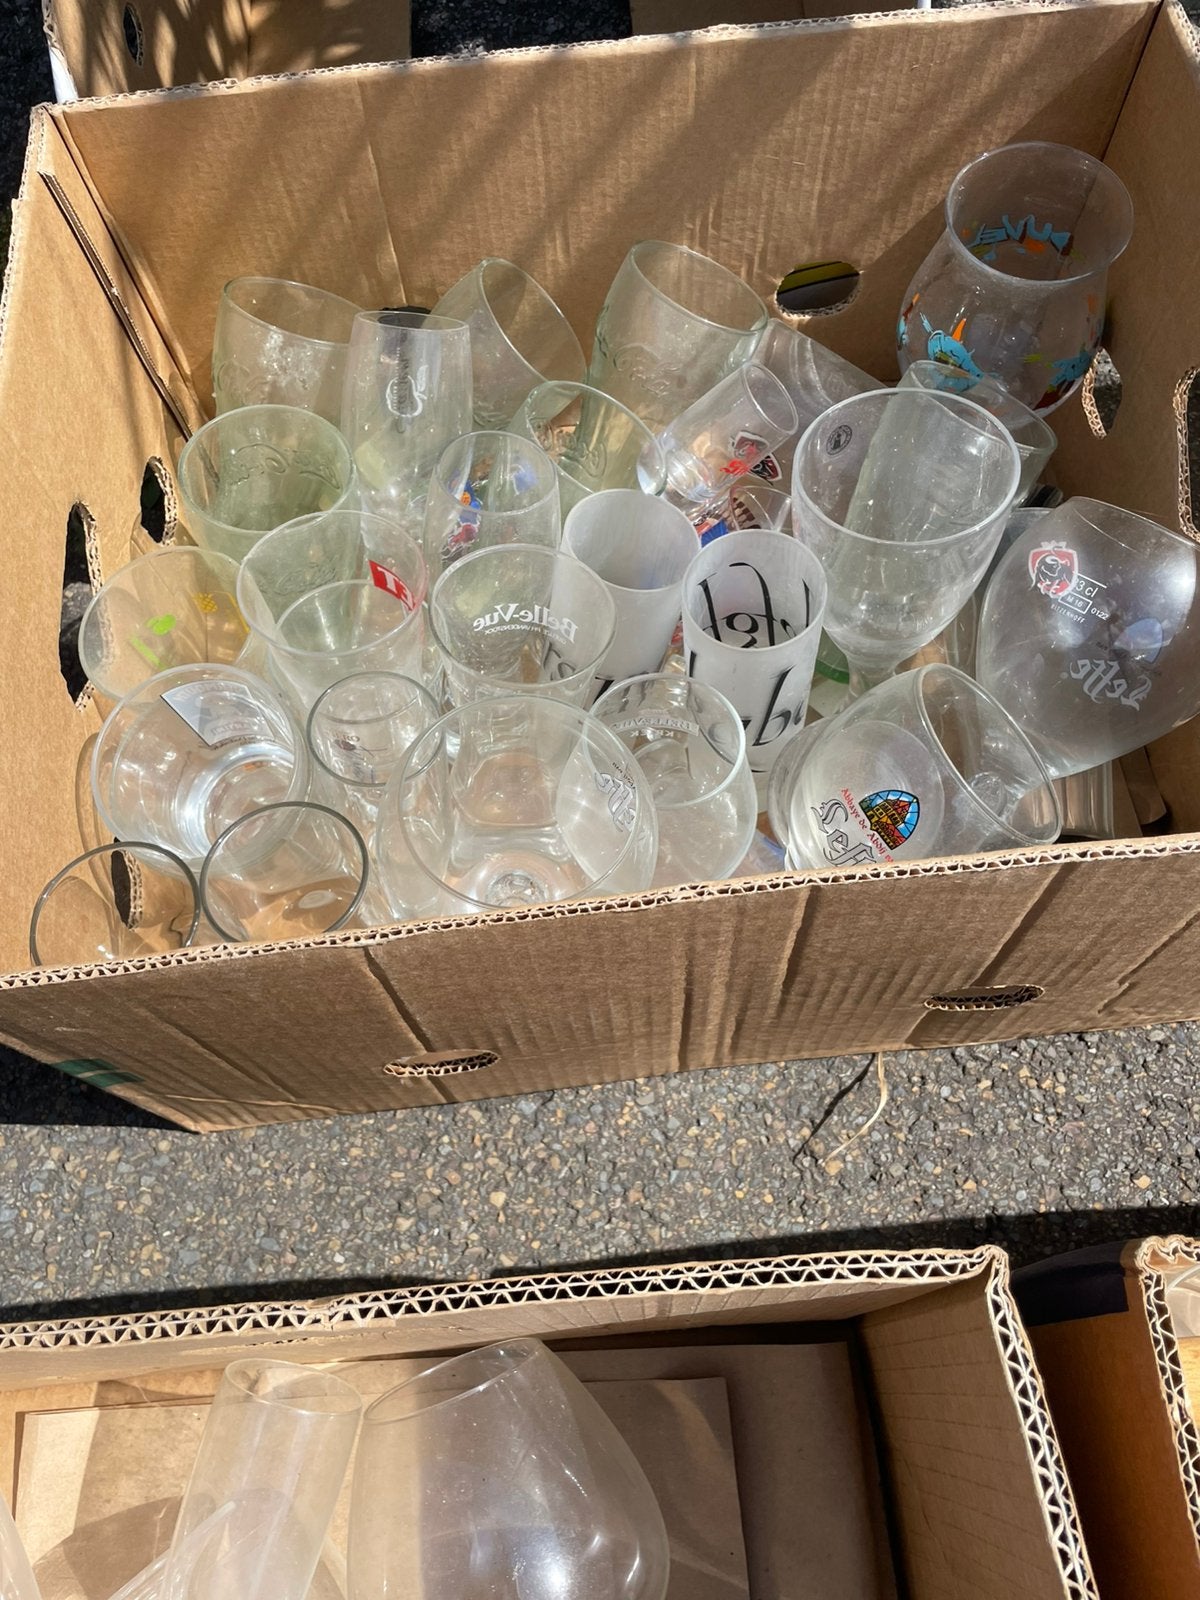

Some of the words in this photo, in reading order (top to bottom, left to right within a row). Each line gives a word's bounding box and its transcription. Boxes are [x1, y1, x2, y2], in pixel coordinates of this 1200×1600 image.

[1090, 607, 1110, 621] 0122
[811, 799, 877, 867] Lef
[841, 787, 861, 819] Abbaye
[858, 818, 868, 831] de
[867, 832, 887, 855] Abdij
